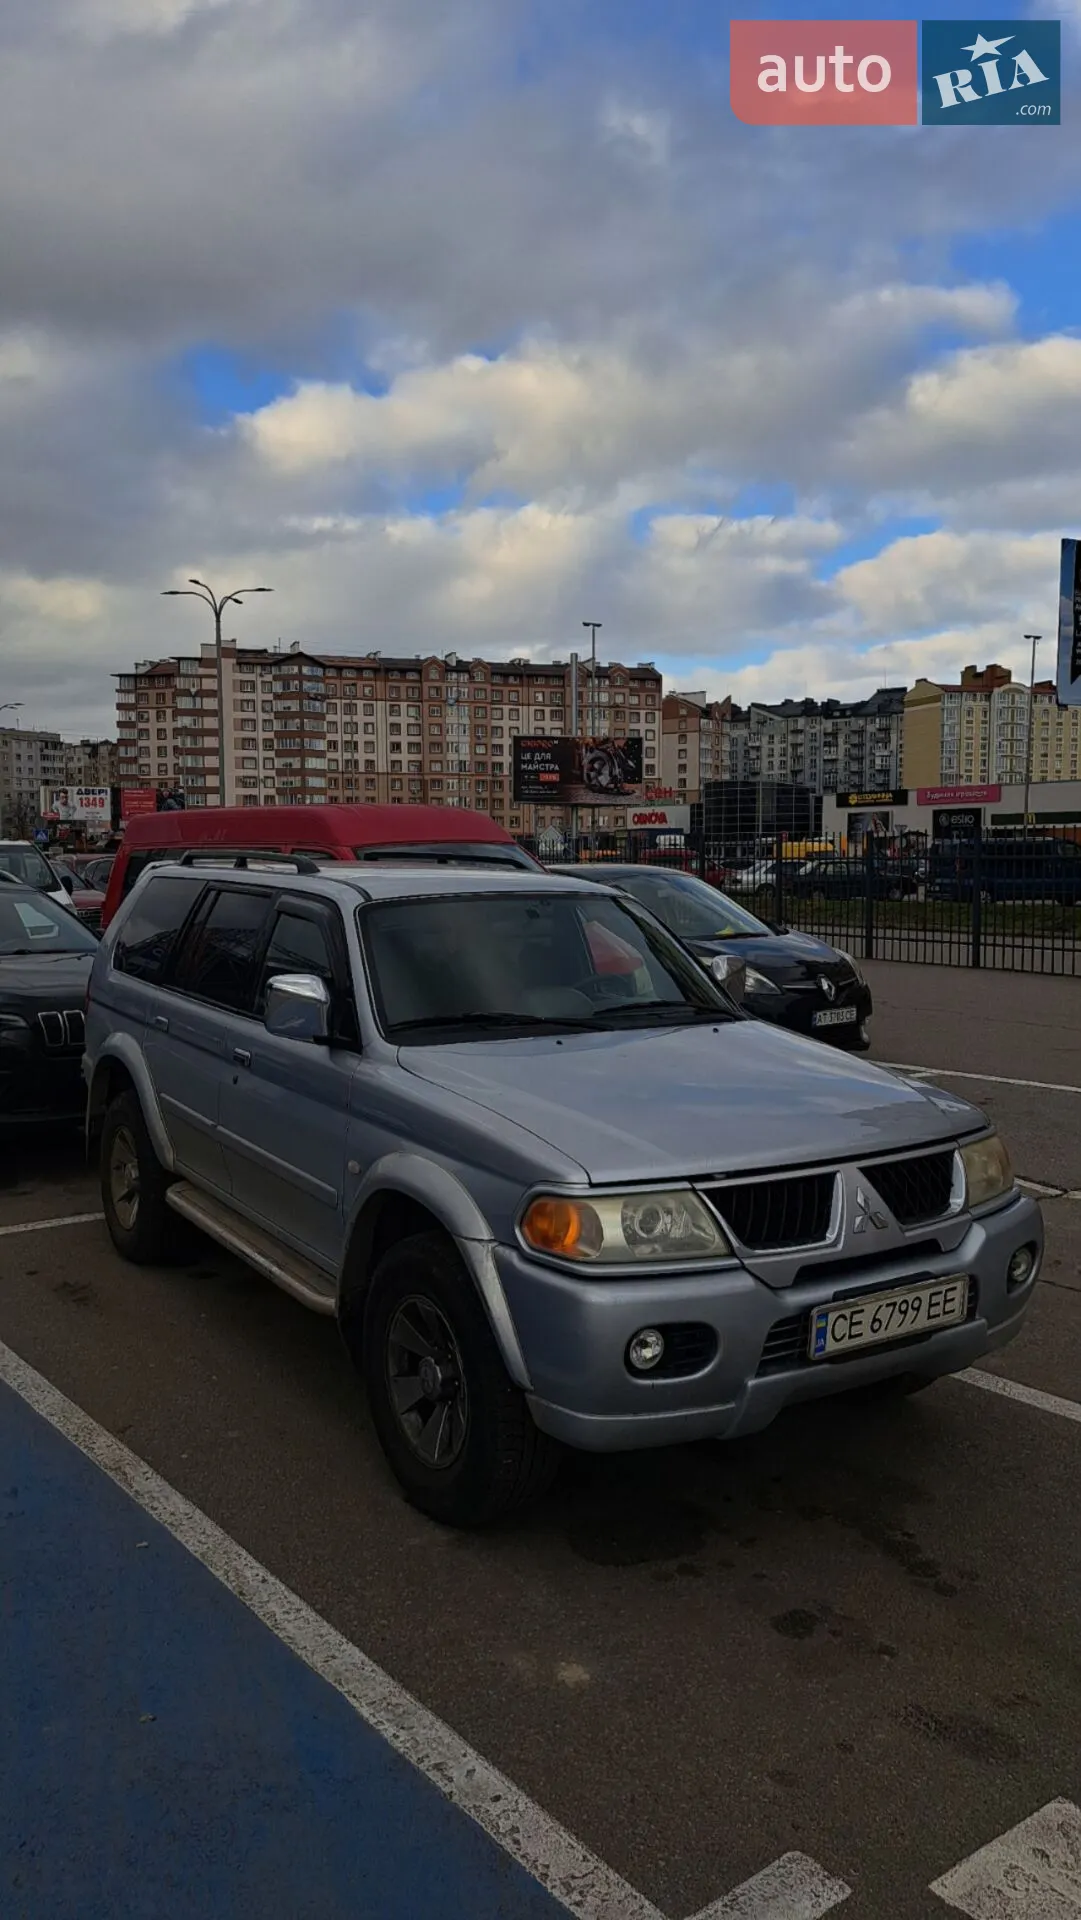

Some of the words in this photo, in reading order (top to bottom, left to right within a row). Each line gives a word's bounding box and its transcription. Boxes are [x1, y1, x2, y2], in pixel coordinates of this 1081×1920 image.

[520, 752, 532, 761] ЦЕ
[534, 752, 551, 761] ДЛЯ
[520, 761, 560, 771] МАЙСТРА
[831, 1309, 865, 1343] CE
[870, 1296, 922, 1334] 6799
[927, 1286, 957, 1320] EE
